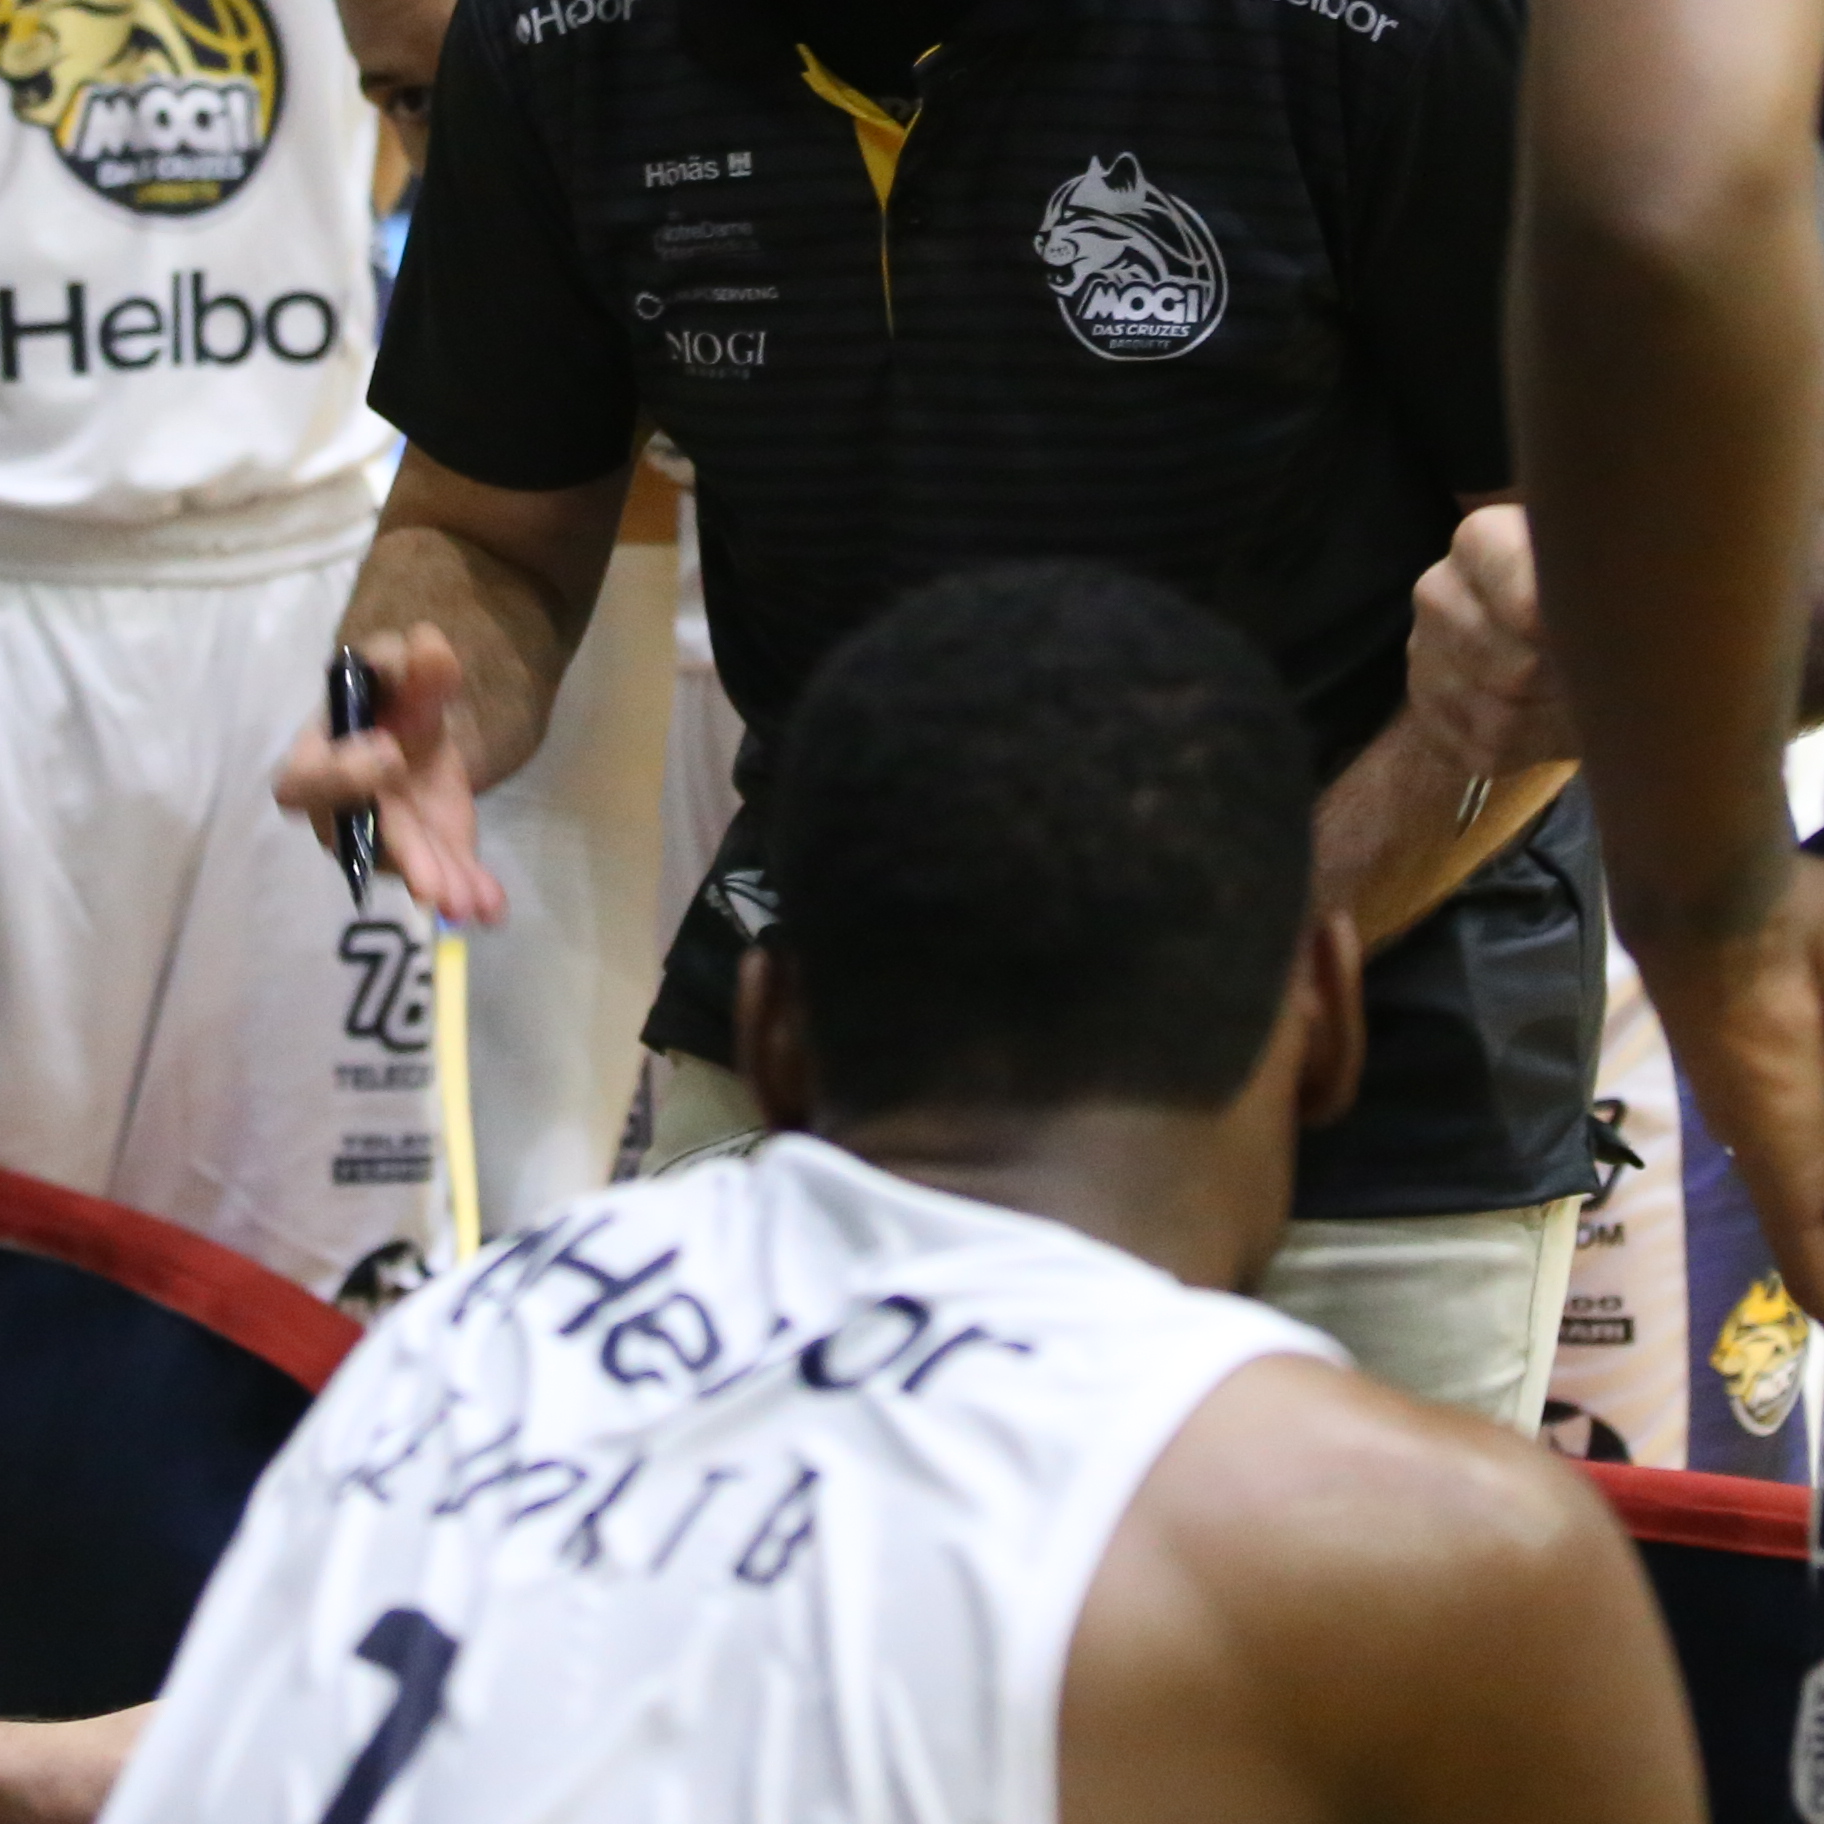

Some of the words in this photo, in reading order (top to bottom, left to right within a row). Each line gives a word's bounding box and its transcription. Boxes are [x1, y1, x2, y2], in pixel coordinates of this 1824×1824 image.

[79, 88, 249, 158] MOGI
[1082, 286, 1199, 323] MOGI
[1092, 324, 1125, 336] DAS
[1126, 324, 1192, 337] CRUZES
